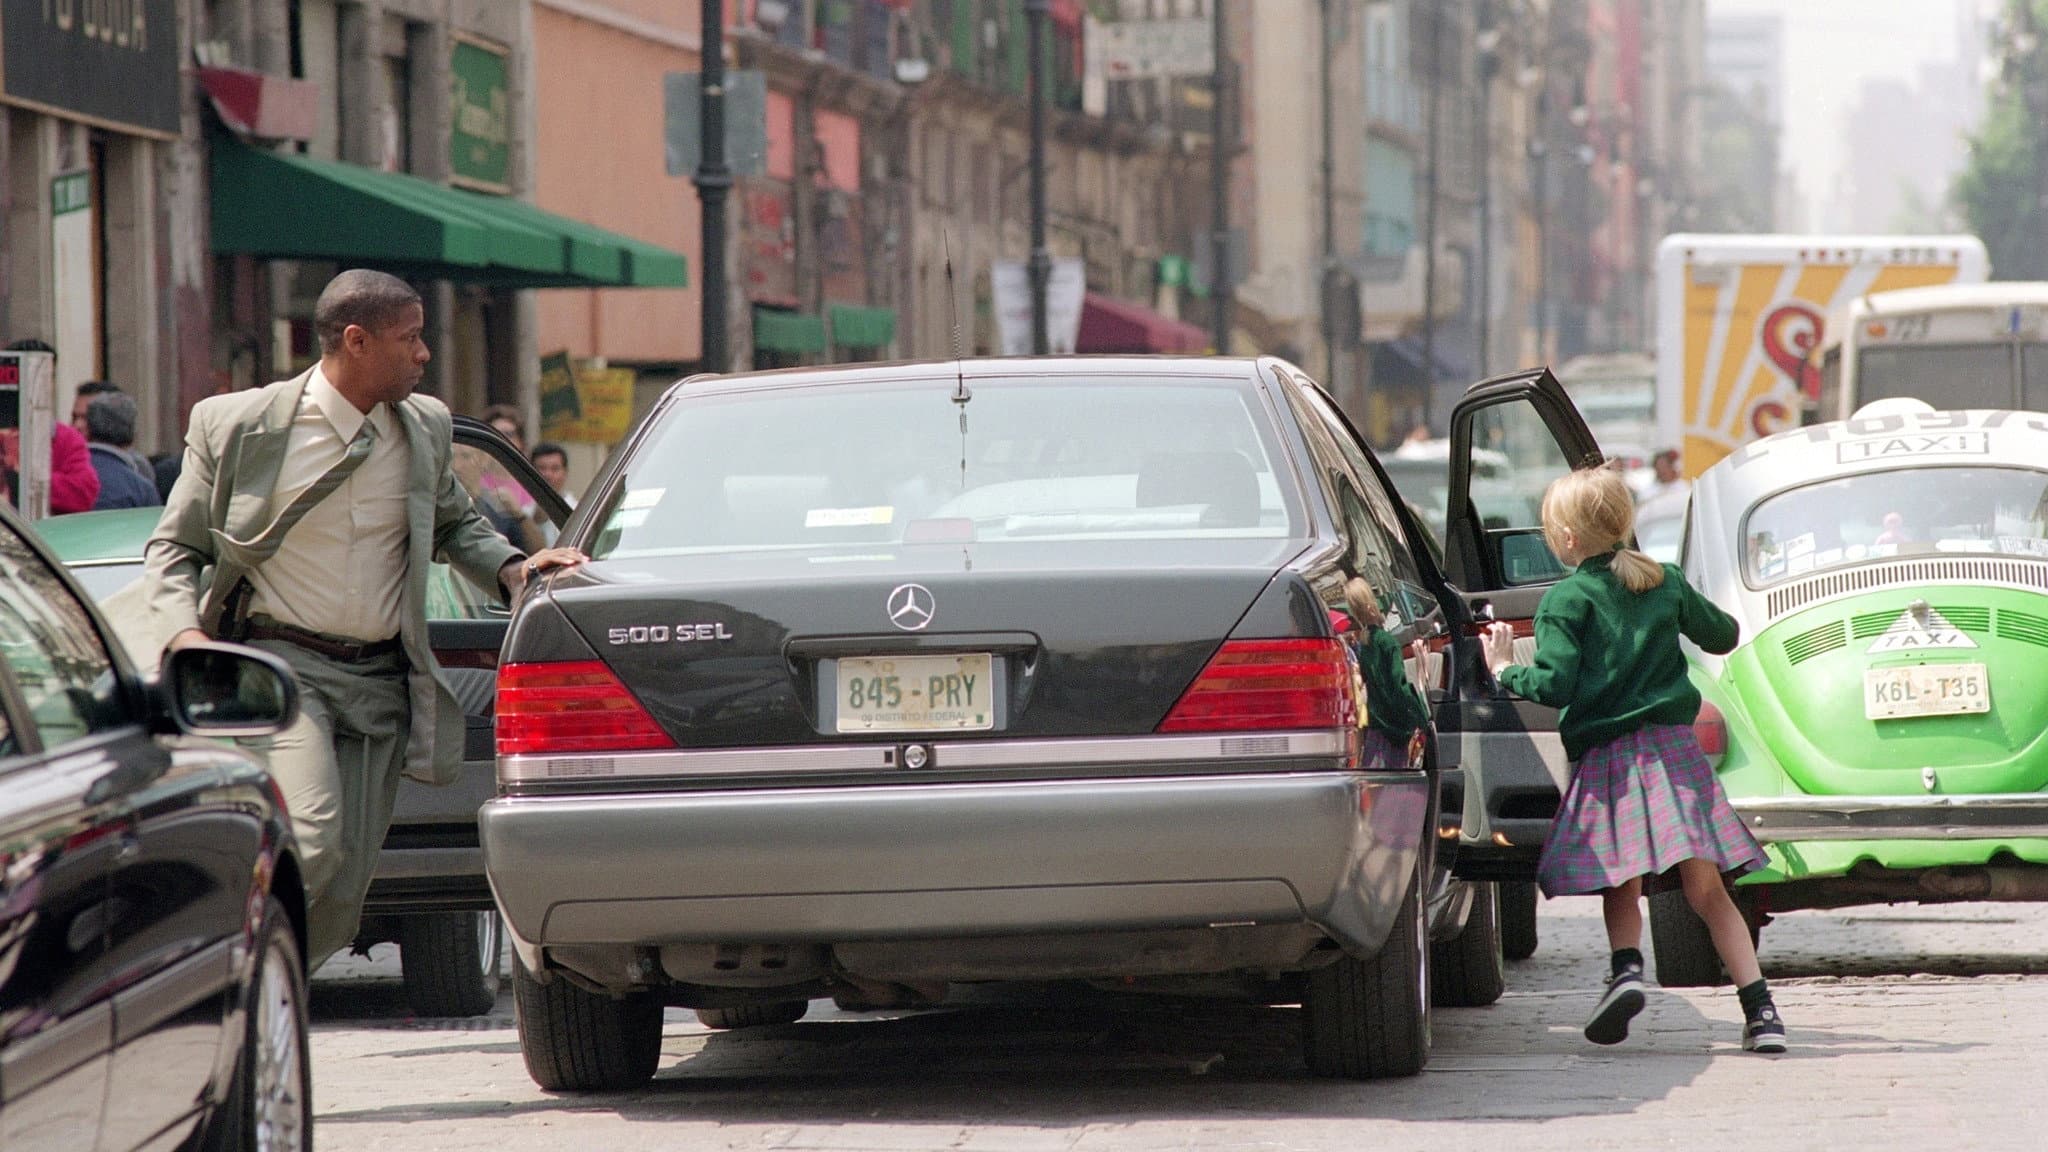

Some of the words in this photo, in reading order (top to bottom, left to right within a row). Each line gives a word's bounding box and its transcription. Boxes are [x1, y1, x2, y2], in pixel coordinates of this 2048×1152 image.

[1854, 435, 1967, 457] TAXI
[608, 626, 670, 645] 500
[676, 622, 733, 642] SEL
[1886, 633, 1958, 647] TAXI
[923, 710, 967, 721] FEDERAL
